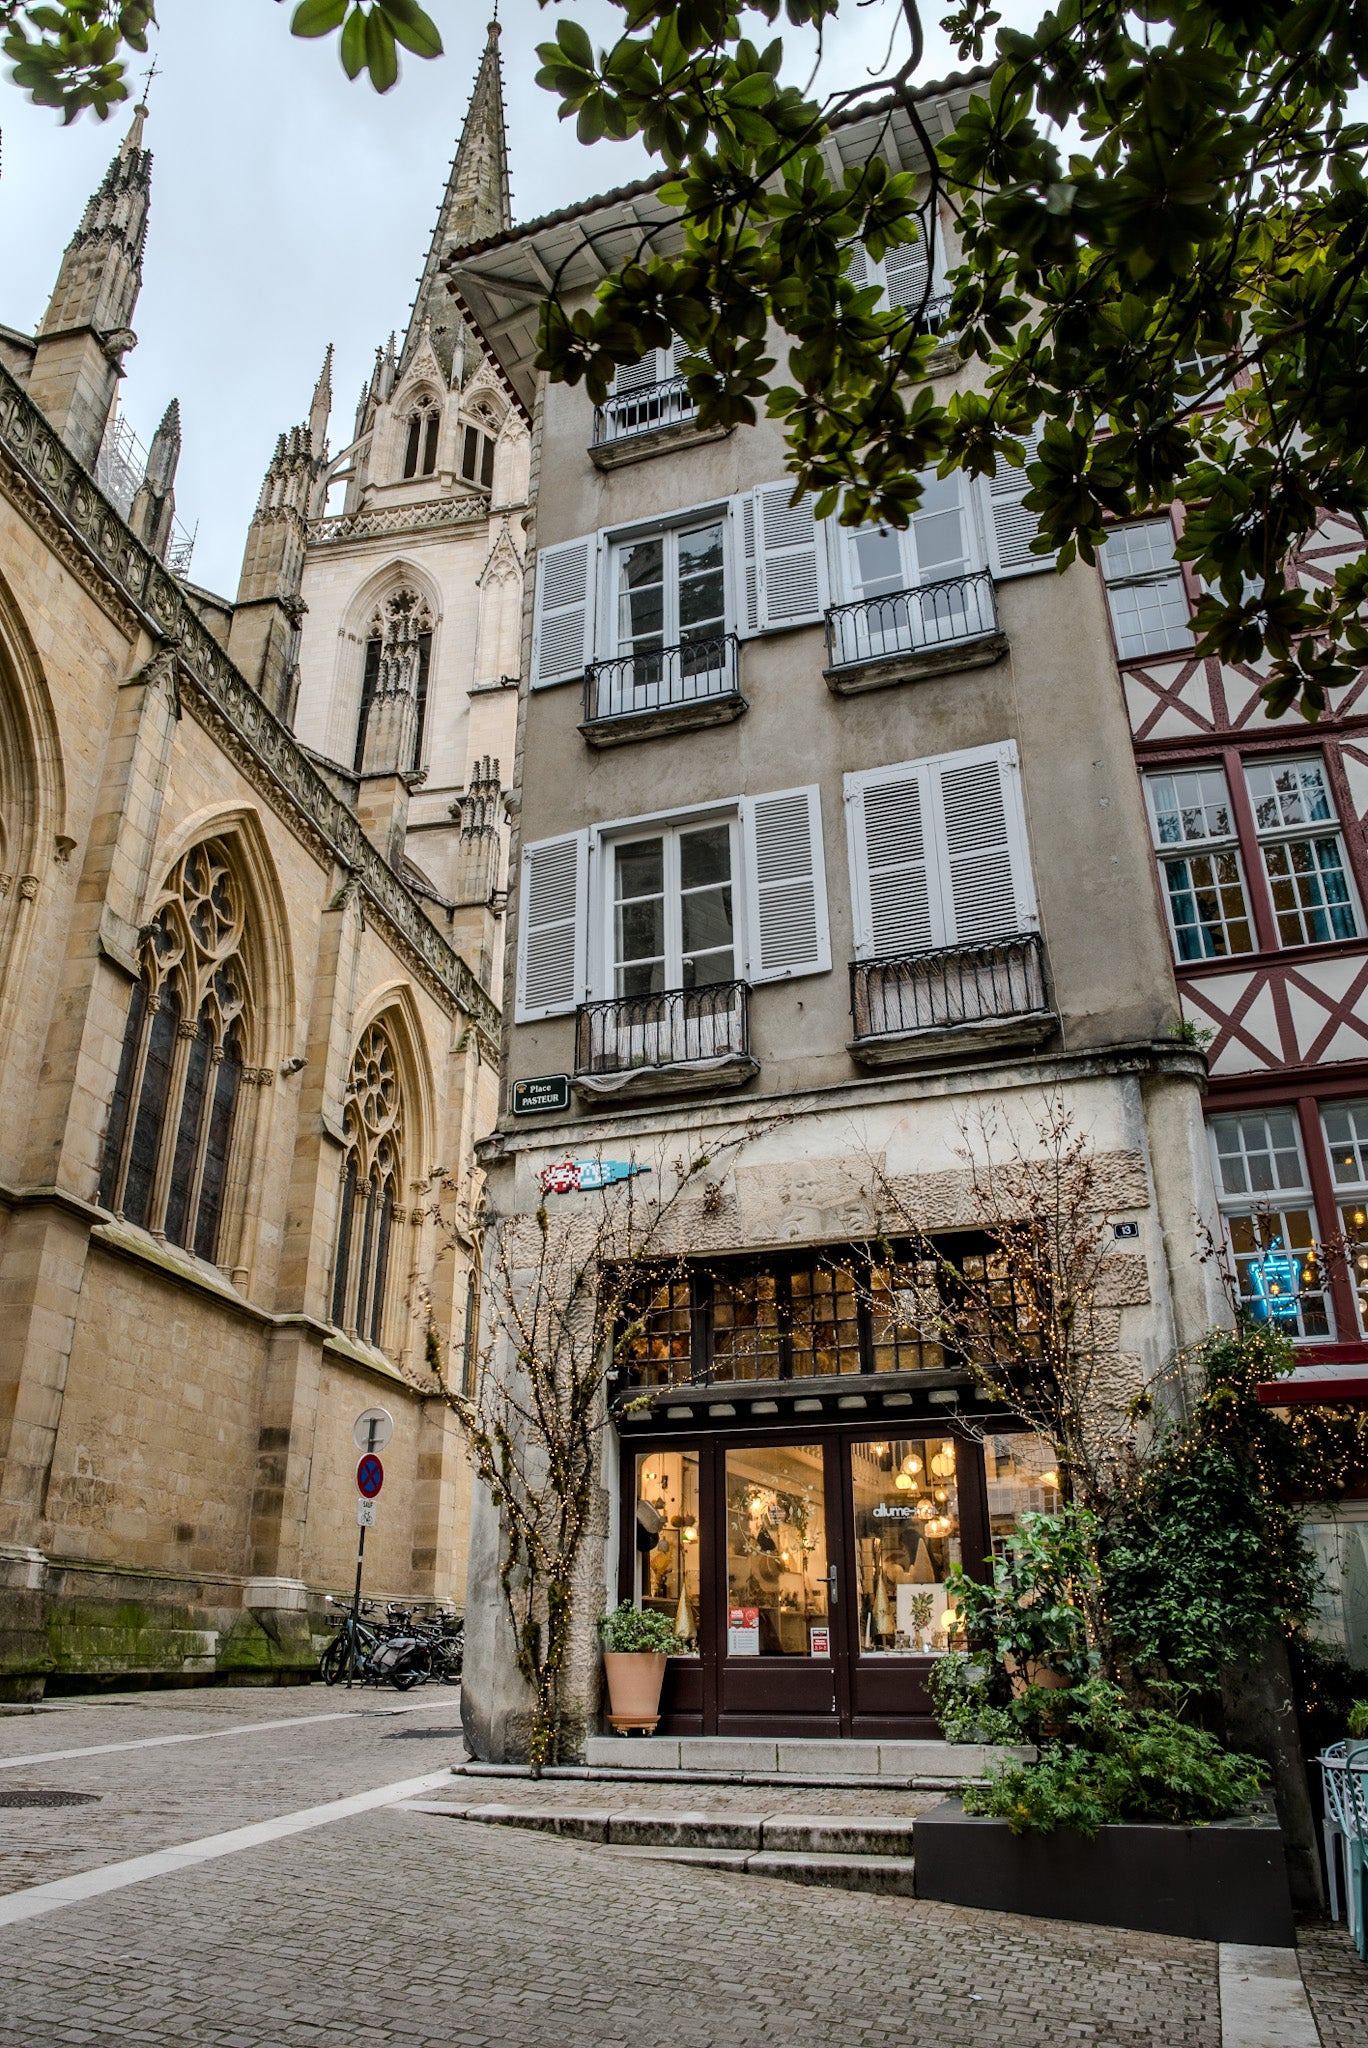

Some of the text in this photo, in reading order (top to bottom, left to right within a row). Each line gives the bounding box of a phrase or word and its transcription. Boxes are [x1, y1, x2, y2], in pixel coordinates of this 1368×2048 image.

[530, 1085, 552, 1093] Place
[522, 1094, 559, 1106] PASTEUR
[362, 1500, 374, 1508] SAUF
